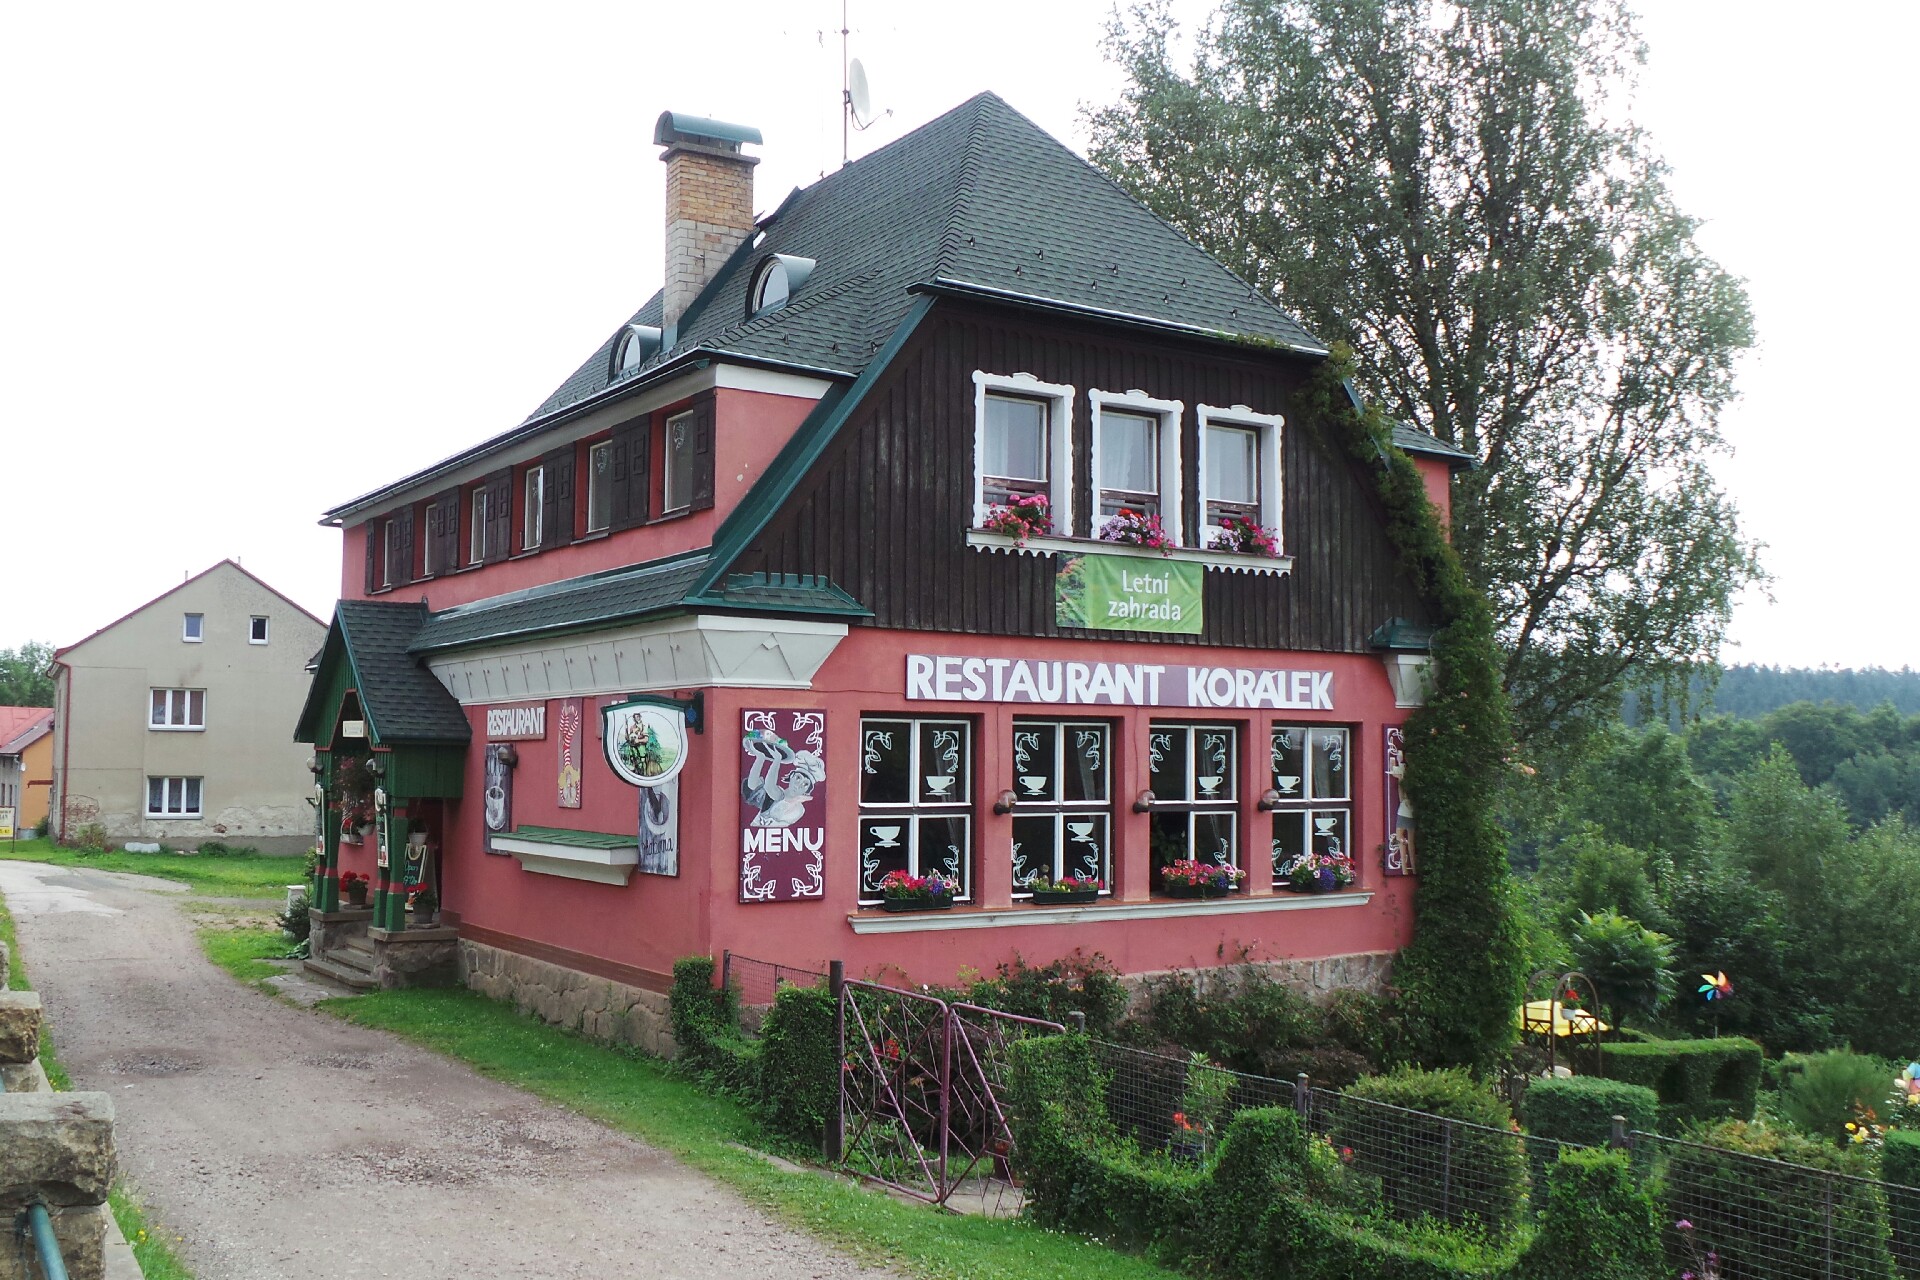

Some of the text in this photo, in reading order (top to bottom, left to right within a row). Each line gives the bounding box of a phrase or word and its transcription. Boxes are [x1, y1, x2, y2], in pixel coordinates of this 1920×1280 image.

[1122, 570, 1169, 594] Letní
[1108, 596, 1181, 621] zahrada
[907, 655, 1335, 710] RESTAURANT KORÁLEK
[487, 706, 545, 736] RESTAURANT
[743, 827, 824, 853] MENU
